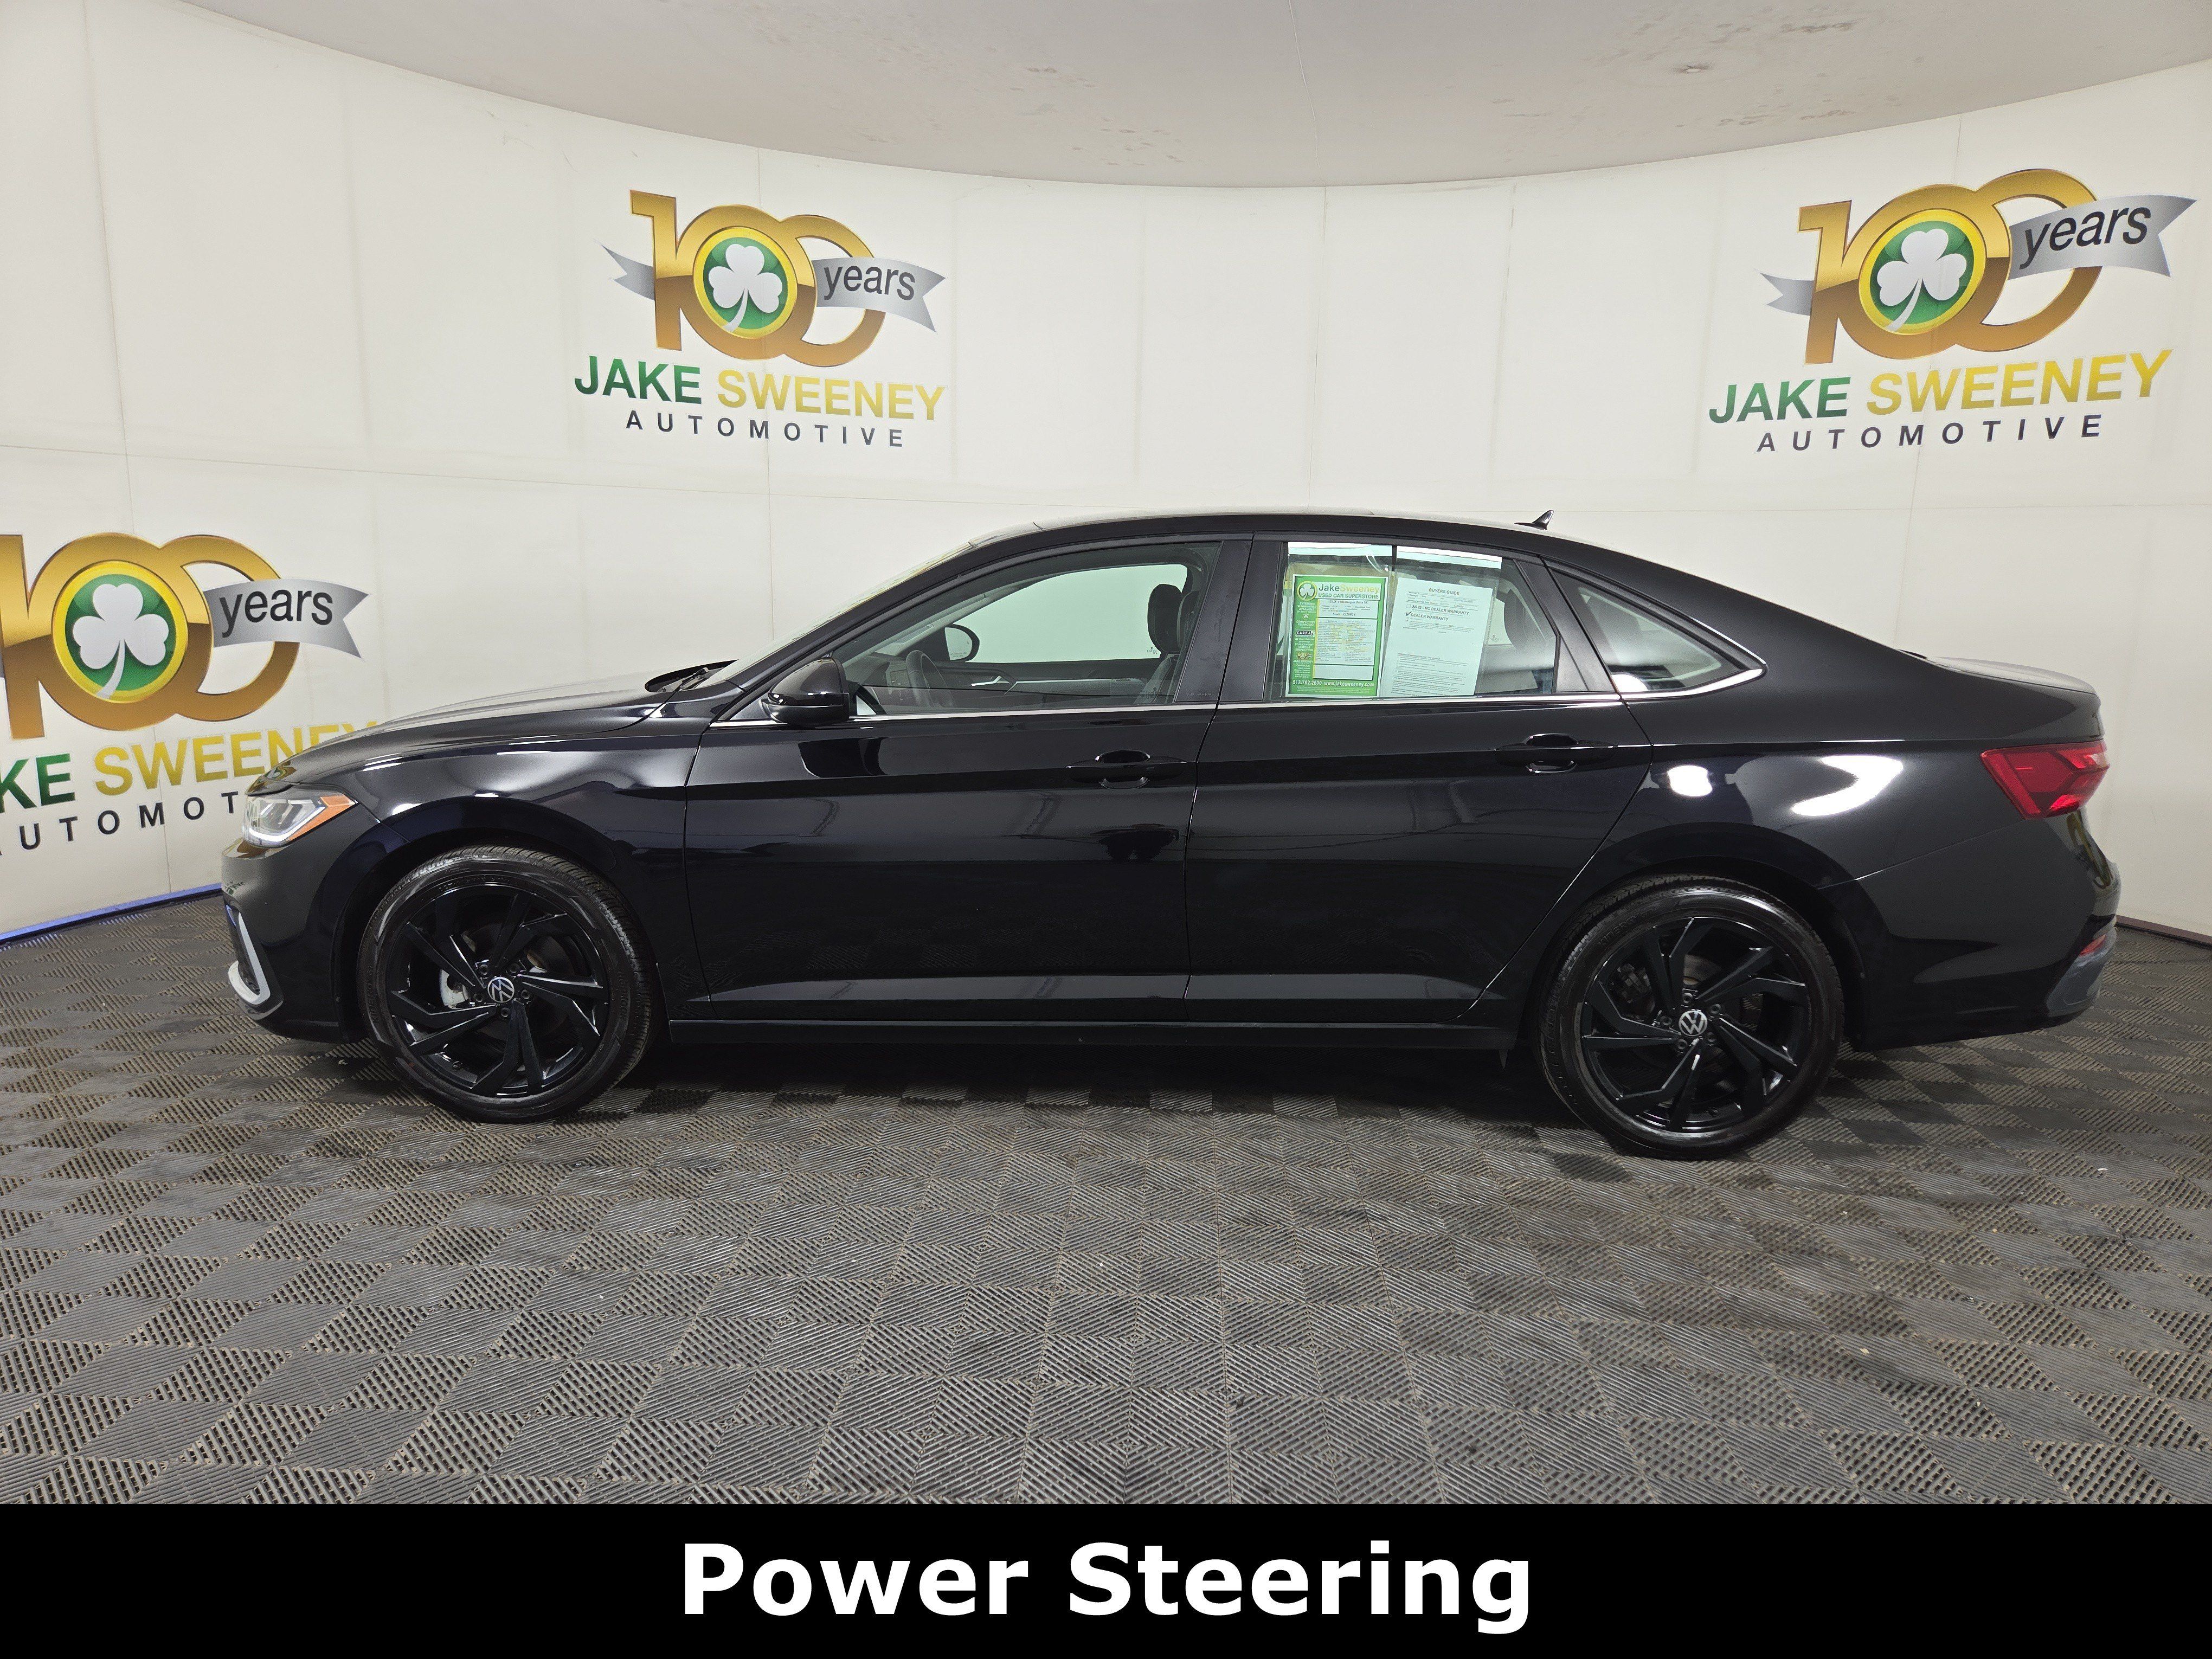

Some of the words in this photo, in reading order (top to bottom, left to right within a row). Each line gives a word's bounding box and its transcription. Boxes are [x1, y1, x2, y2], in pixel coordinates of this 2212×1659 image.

[630, 190, 885, 367] 100
[824, 265, 915, 300] years
[1797, 169, 2102, 364] 100
[2018, 207, 2151, 269] years
[574, 356, 702, 404] JAKE
[717, 370, 945, 421] SWEENEY
[1709, 377, 1850, 423] JAKE
[1867, 349, 2172, 415] SWEENEY
[626, 410, 902, 447] AUTOMOTIVE
[1757, 414, 2101, 453] AUTOMOTIVE
[218, 589, 333, 638] years
[94, 721, 377, 796] SWEEN
